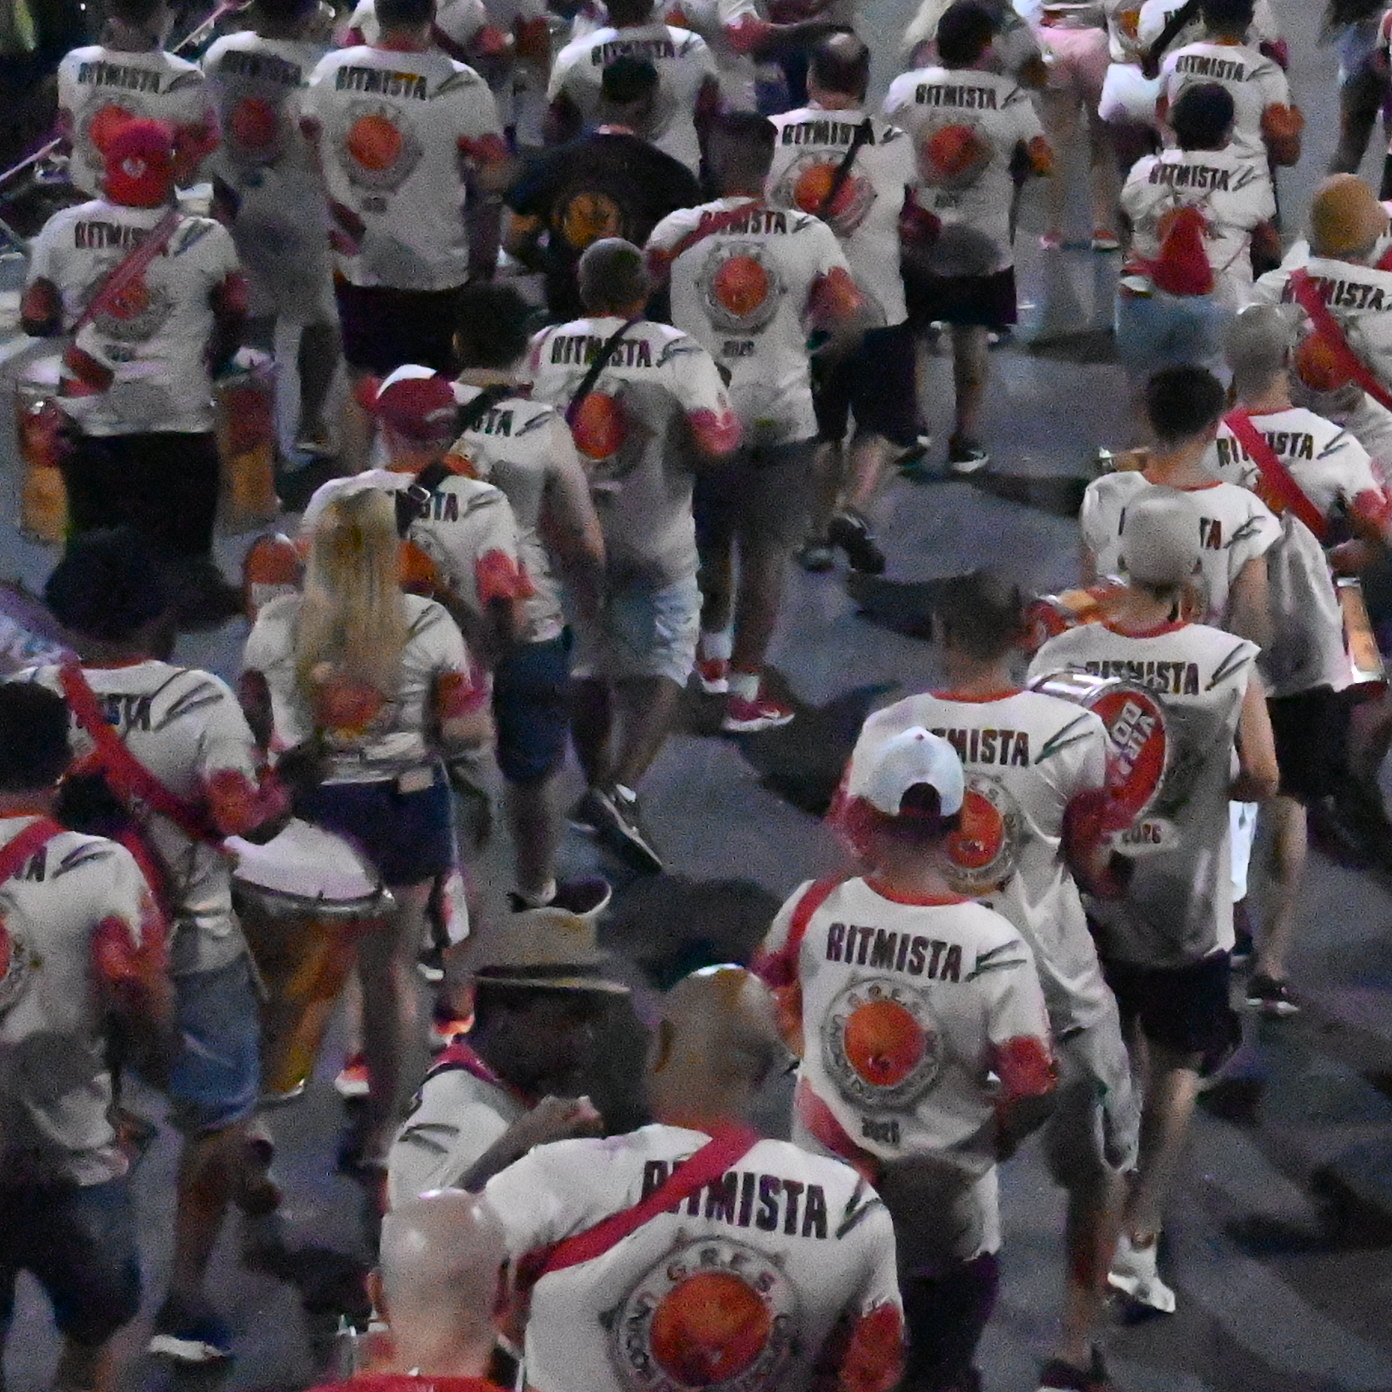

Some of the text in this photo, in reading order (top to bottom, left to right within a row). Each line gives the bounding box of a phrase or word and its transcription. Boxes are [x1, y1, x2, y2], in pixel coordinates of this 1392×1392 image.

[1175, 54, 1245, 82] RITMISTA
[335, 65, 428, 101] RITMISTA
[915, 83, 997, 109] RITMISTA
[1148, 163, 1229, 191] RITMISTA
[827, 922, 962, 981] RITMISTA
